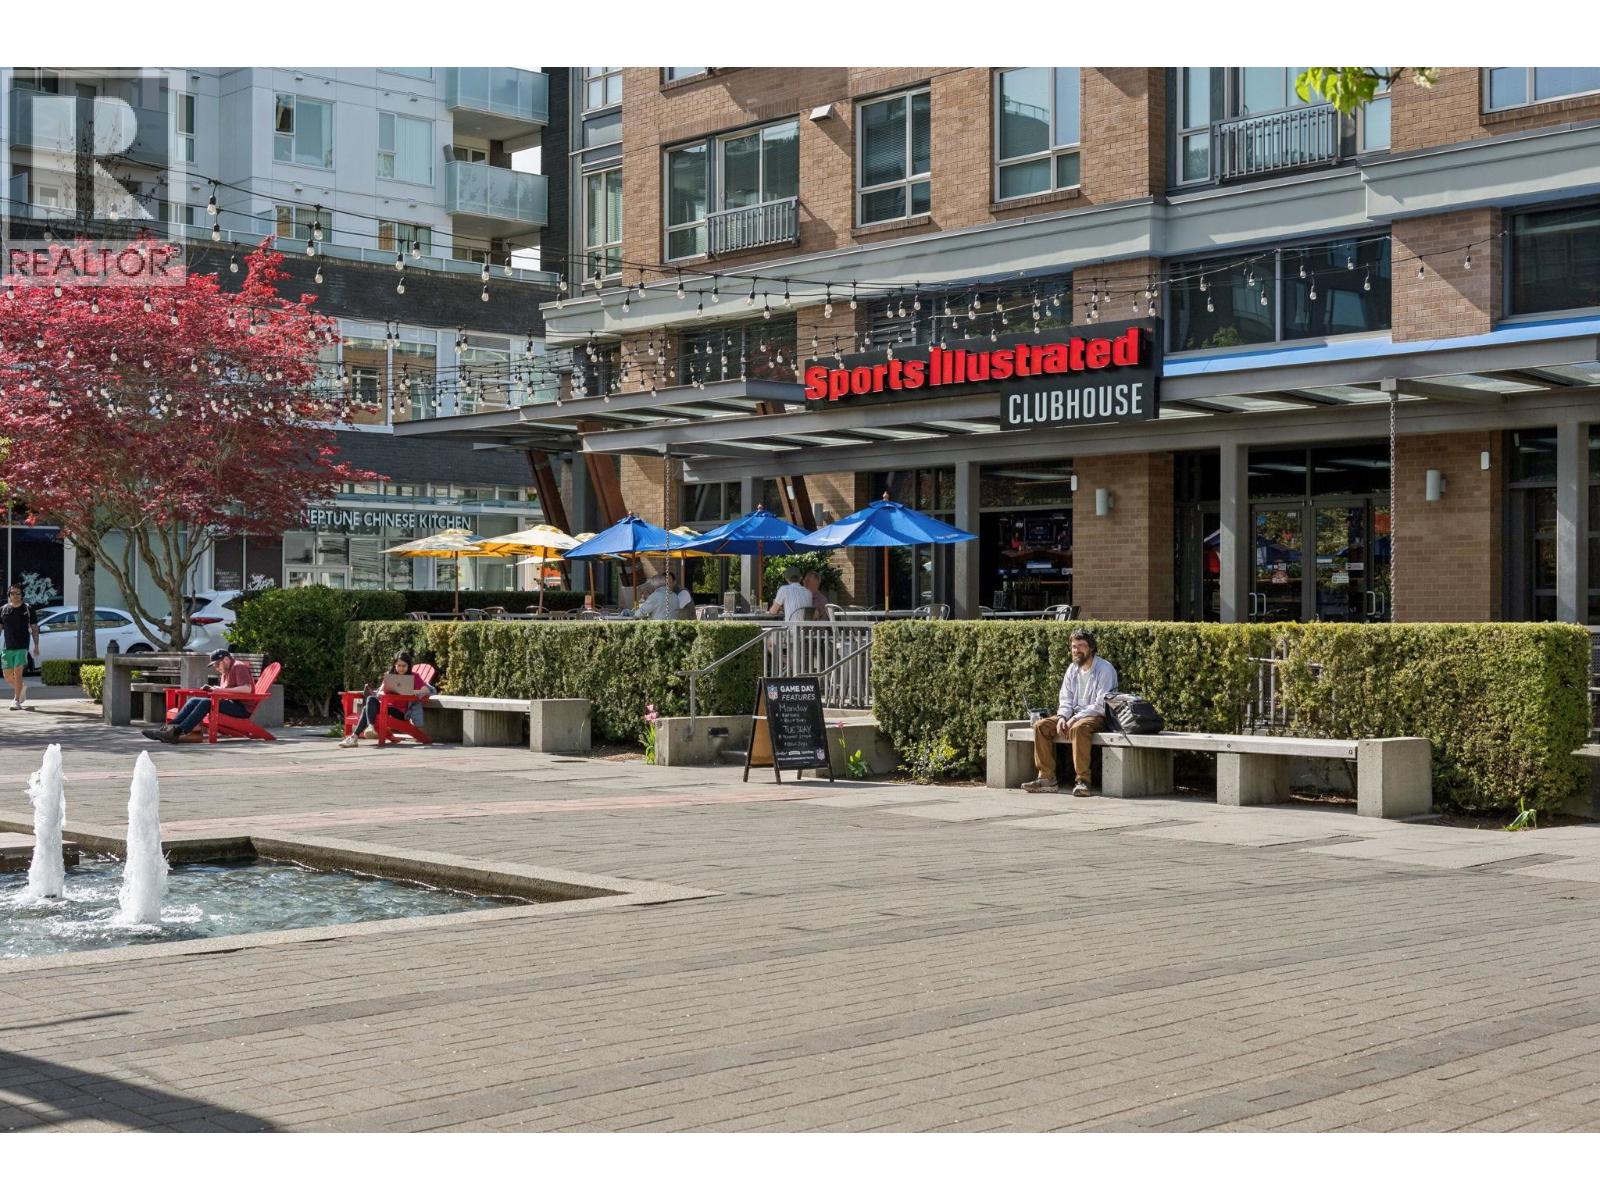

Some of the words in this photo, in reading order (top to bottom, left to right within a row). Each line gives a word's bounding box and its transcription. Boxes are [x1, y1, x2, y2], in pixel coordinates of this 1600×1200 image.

[804, 358, 925, 401] Sports
[929, 327, 1140, 386] Illustrated
[1008, 382, 1144, 425] CLUBHOUSE
[300, 509, 360, 526] NEPTUNE
[363, 511, 416, 528] CHINESE
[419, 513, 472, 530] KITCHEN
